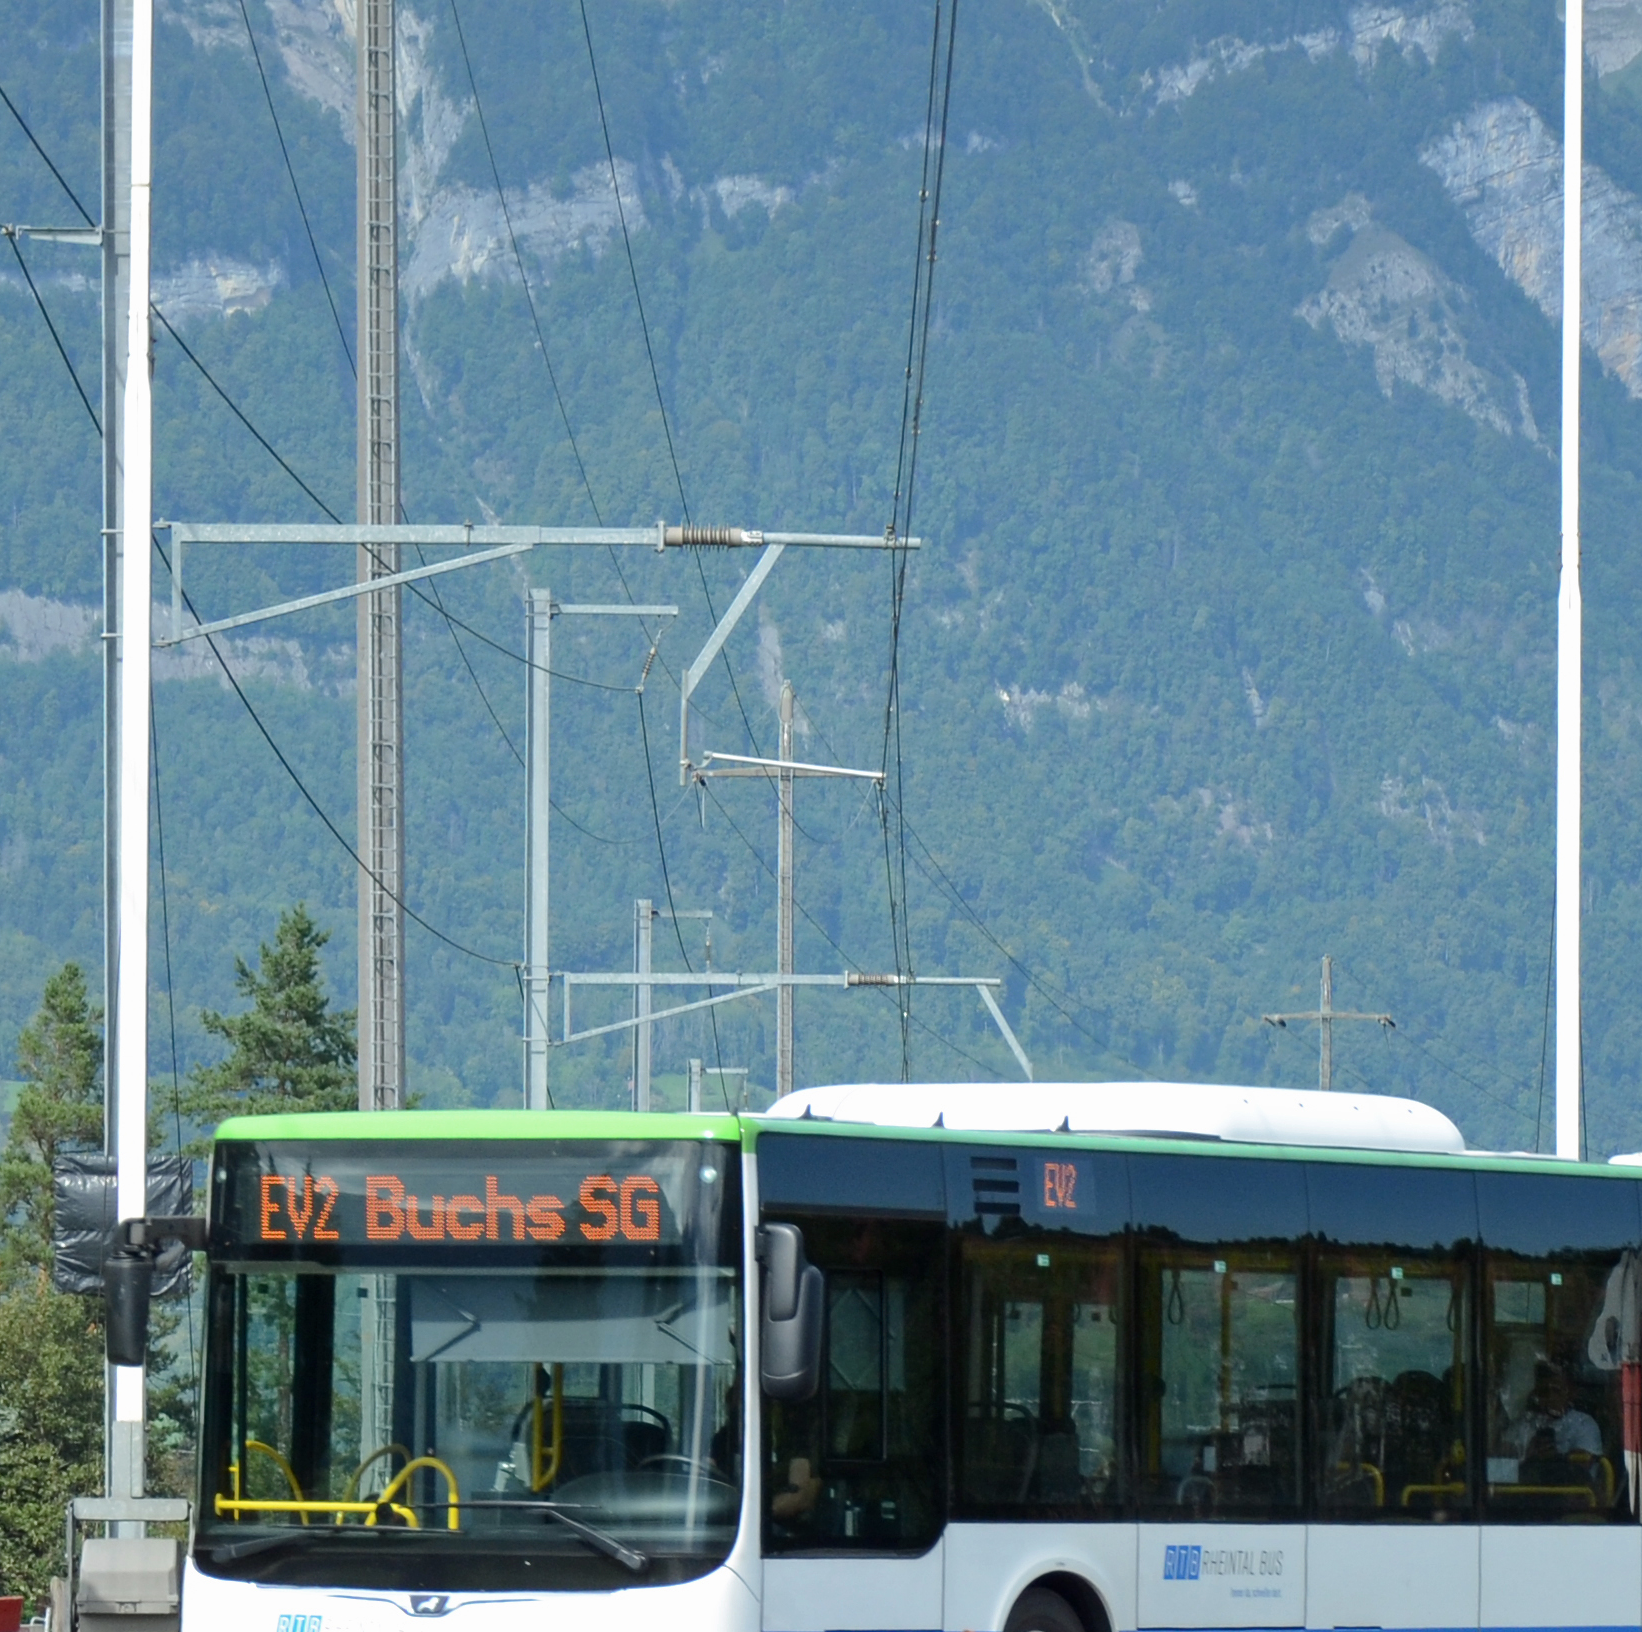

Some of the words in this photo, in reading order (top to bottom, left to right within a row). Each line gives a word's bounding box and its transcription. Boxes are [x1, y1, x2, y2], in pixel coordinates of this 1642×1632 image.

[260, 1174, 340, 1240] EV2
[366, 1174, 567, 1240] Buchs
[579, 1174, 660, 1241] SG
[1044, 1163, 1077, 1209] EV2
[1165, 1546, 1201, 1579] RTB
[1202, 1550, 1255, 1576] RHEINTAL
[1259, 1550, 1284, 1576] BUS
